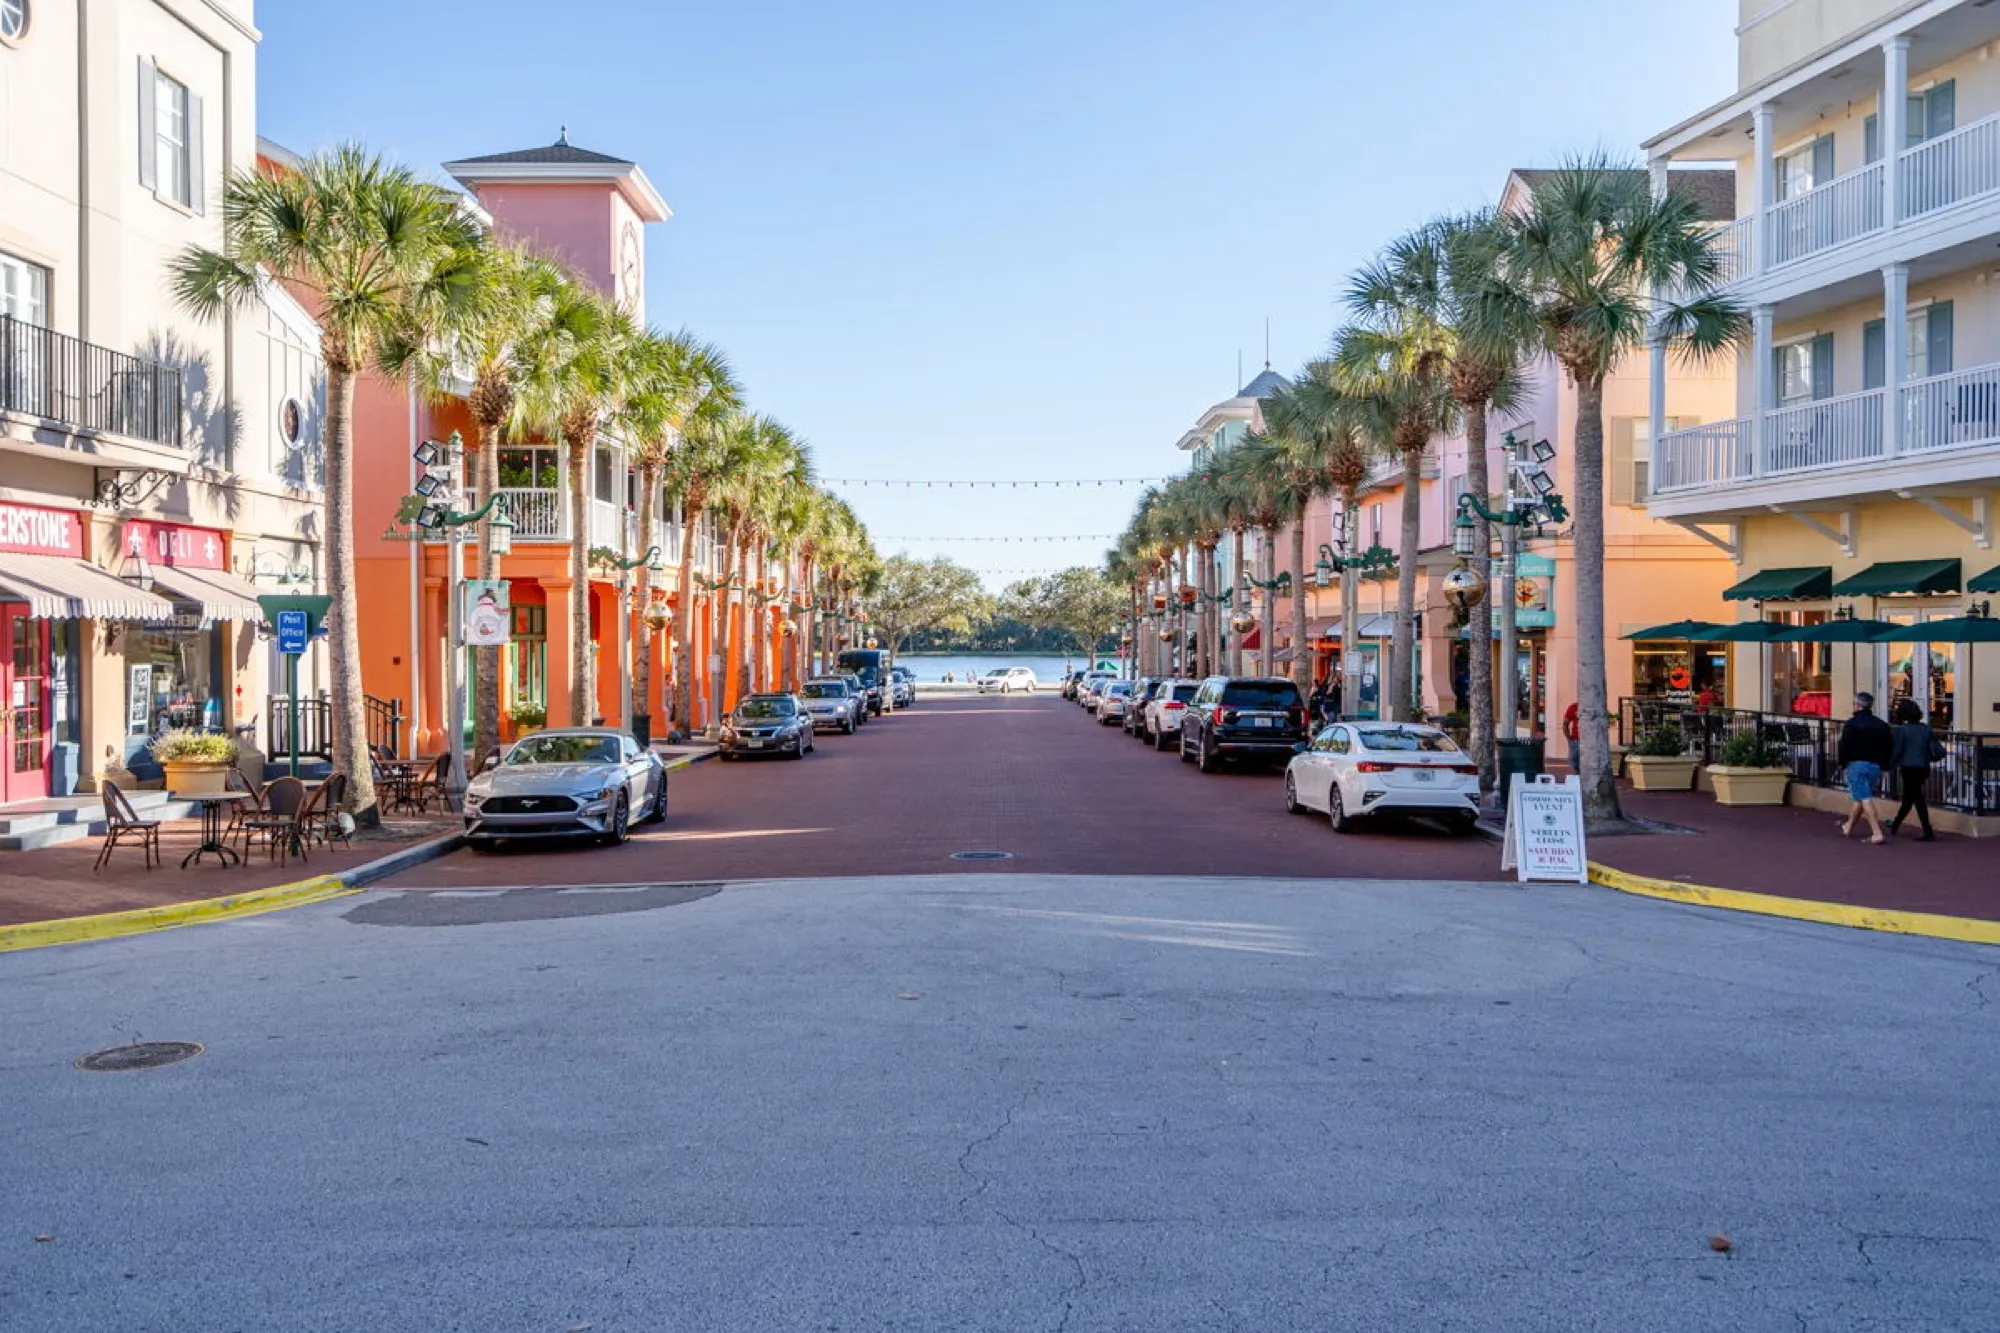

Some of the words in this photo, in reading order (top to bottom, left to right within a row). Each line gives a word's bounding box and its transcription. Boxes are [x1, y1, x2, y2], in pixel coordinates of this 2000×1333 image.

[0, 505, 71, 549] ERSTONE
[159, 529, 193, 558] DELI
[283, 614, 300, 624] Post
[281, 628, 304, 637] Office
[1534, 803, 1563, 811] EVENT
[1528, 848, 1574, 856] SATURDAY
